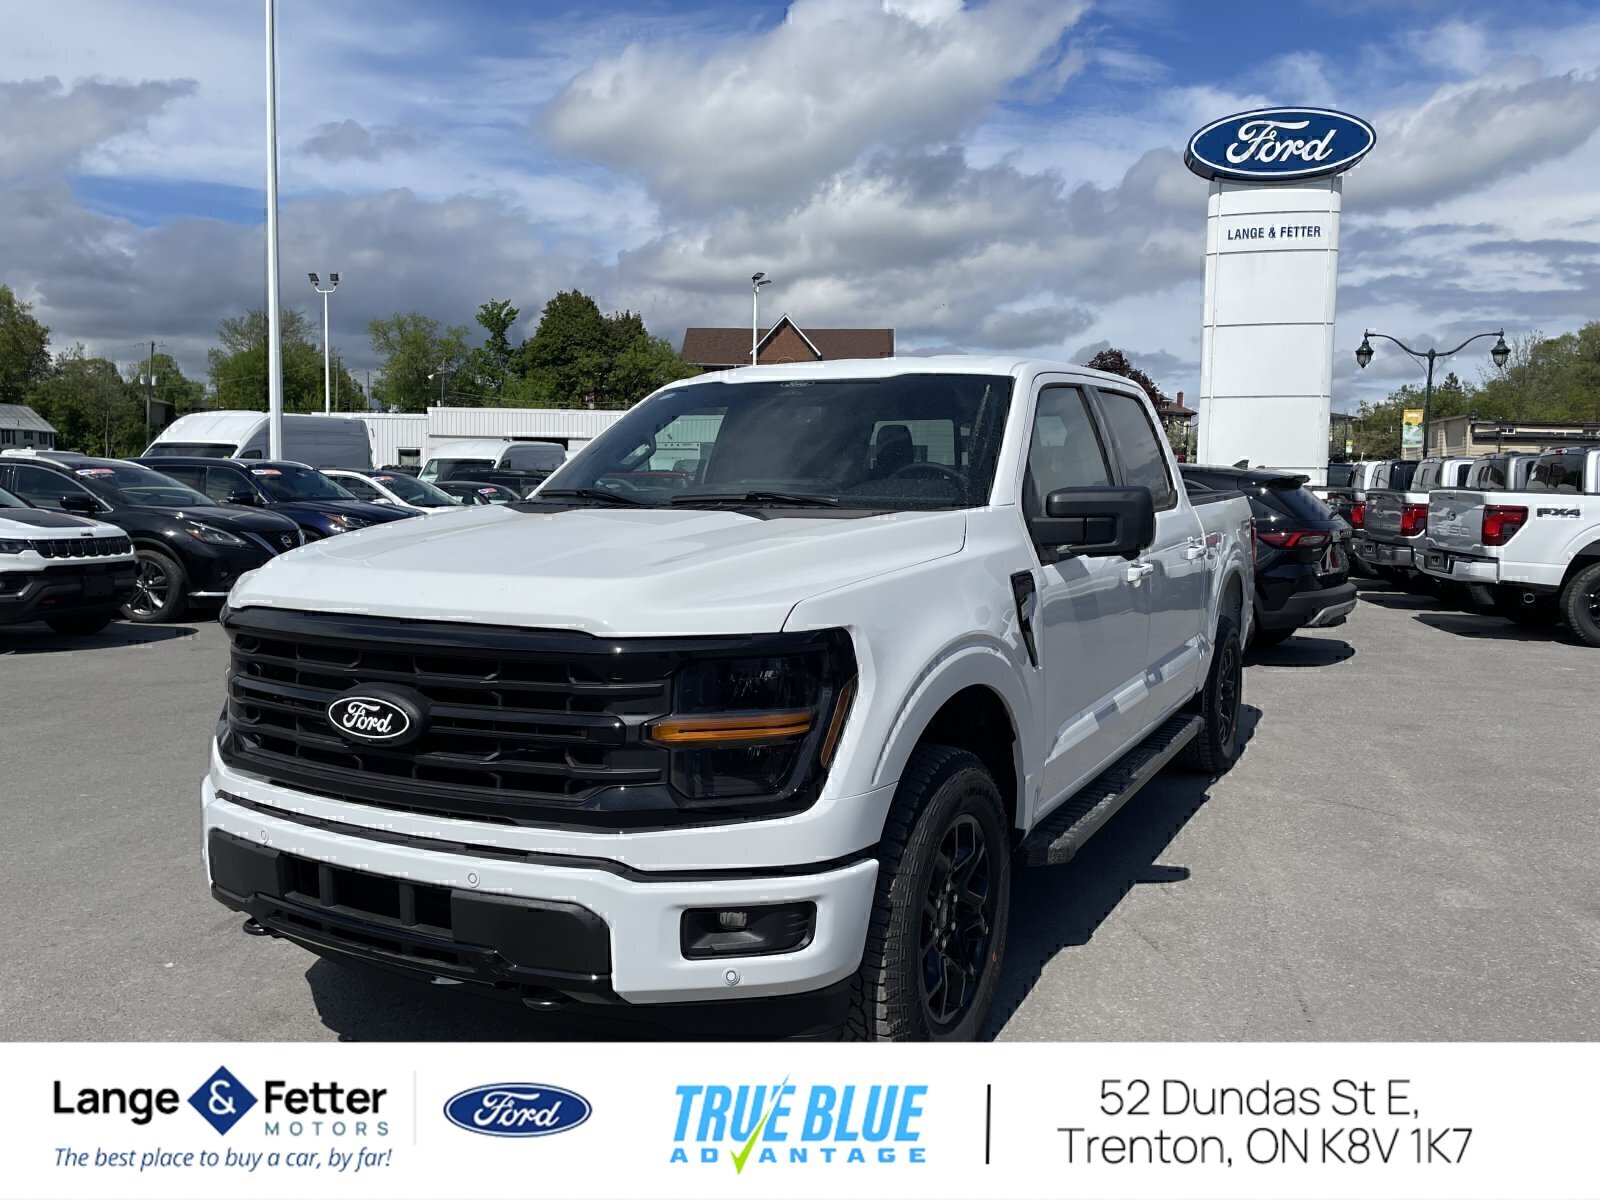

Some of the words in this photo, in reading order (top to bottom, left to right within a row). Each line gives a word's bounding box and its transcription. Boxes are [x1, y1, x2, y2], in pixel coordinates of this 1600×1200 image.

[1226, 120, 1338, 164] Ford
[1227, 227, 1265, 241] LANGE
[1268, 227, 1276, 239] &
[1280, 225, 1321, 239] FETTER
[1536, 507, 1581, 518] FX4
[342, 701, 393, 733] Ford
